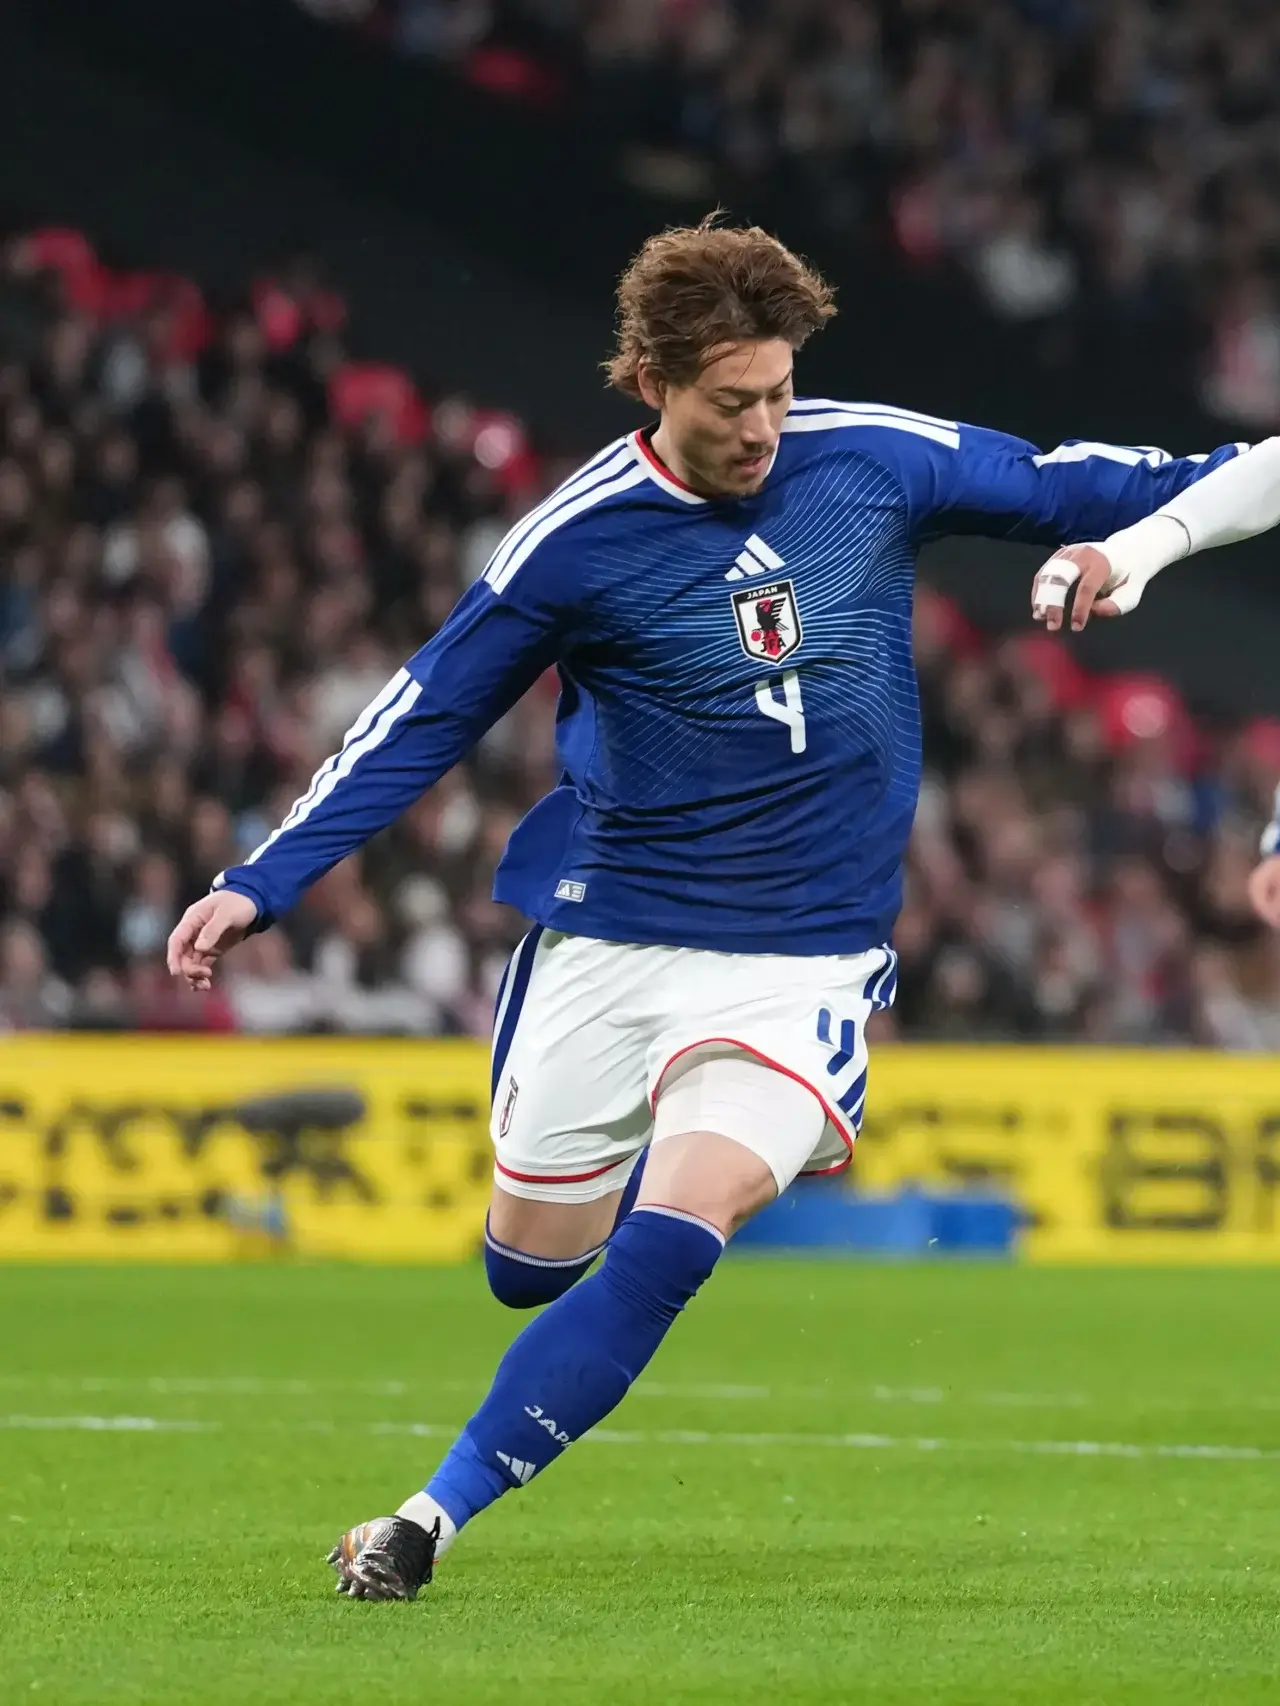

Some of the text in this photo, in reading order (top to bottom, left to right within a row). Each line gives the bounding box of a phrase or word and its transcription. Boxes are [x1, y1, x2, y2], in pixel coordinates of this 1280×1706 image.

[746, 586, 778, 600] JAPAN
[754, 669, 806, 754] 4
[817, 1007, 855, 1076] 4
